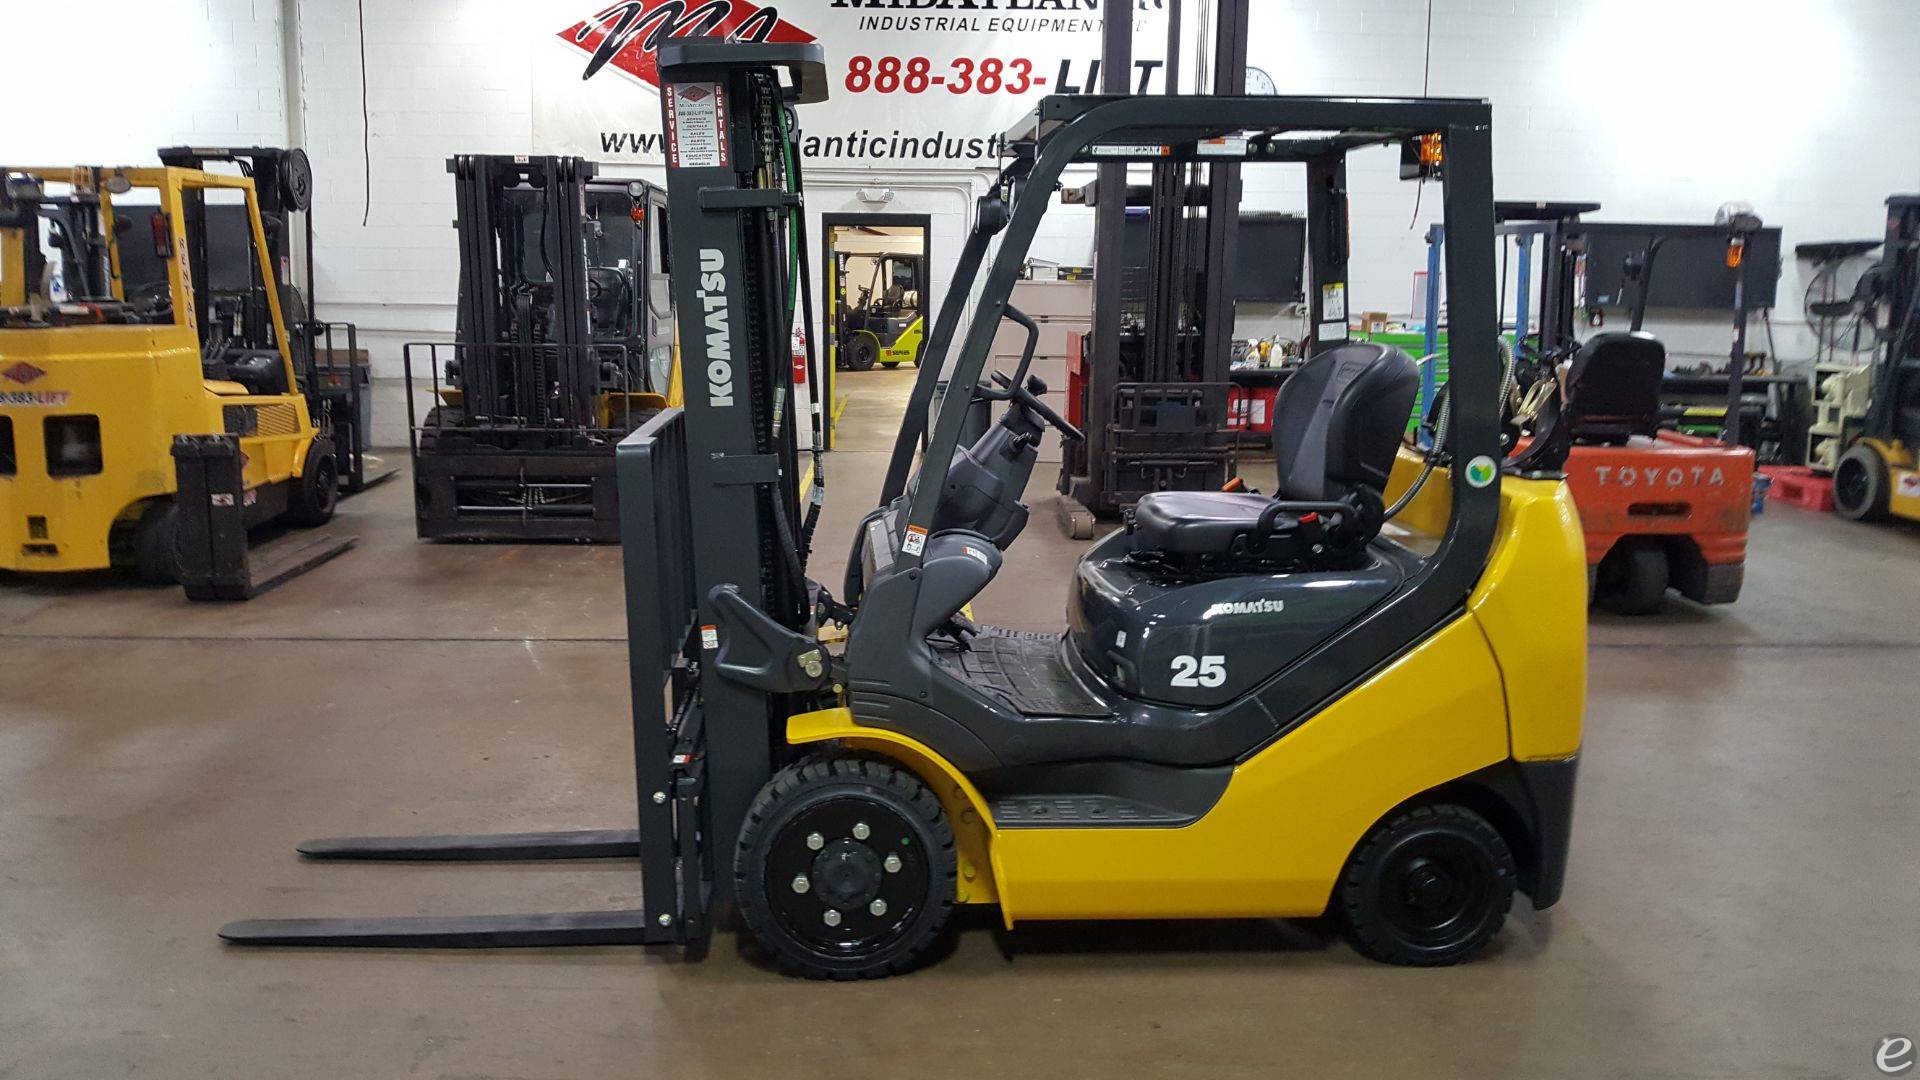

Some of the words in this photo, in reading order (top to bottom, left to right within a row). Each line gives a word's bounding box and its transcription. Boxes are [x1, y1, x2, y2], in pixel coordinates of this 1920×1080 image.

[859, 16, 980, 31] INDUSTRIAL
[844, 55, 1163, 96] 888-383-LIT
[666, 86, 678, 163] SERVICE
[715, 85, 727, 162] RENTALS
[696, 248, 734, 407] KOMATSU
[1594, 466, 1726, 487] TOYOTA
[1210, 598, 1285, 616] KOMATSU
[1170, 655, 1227, 688] 25
